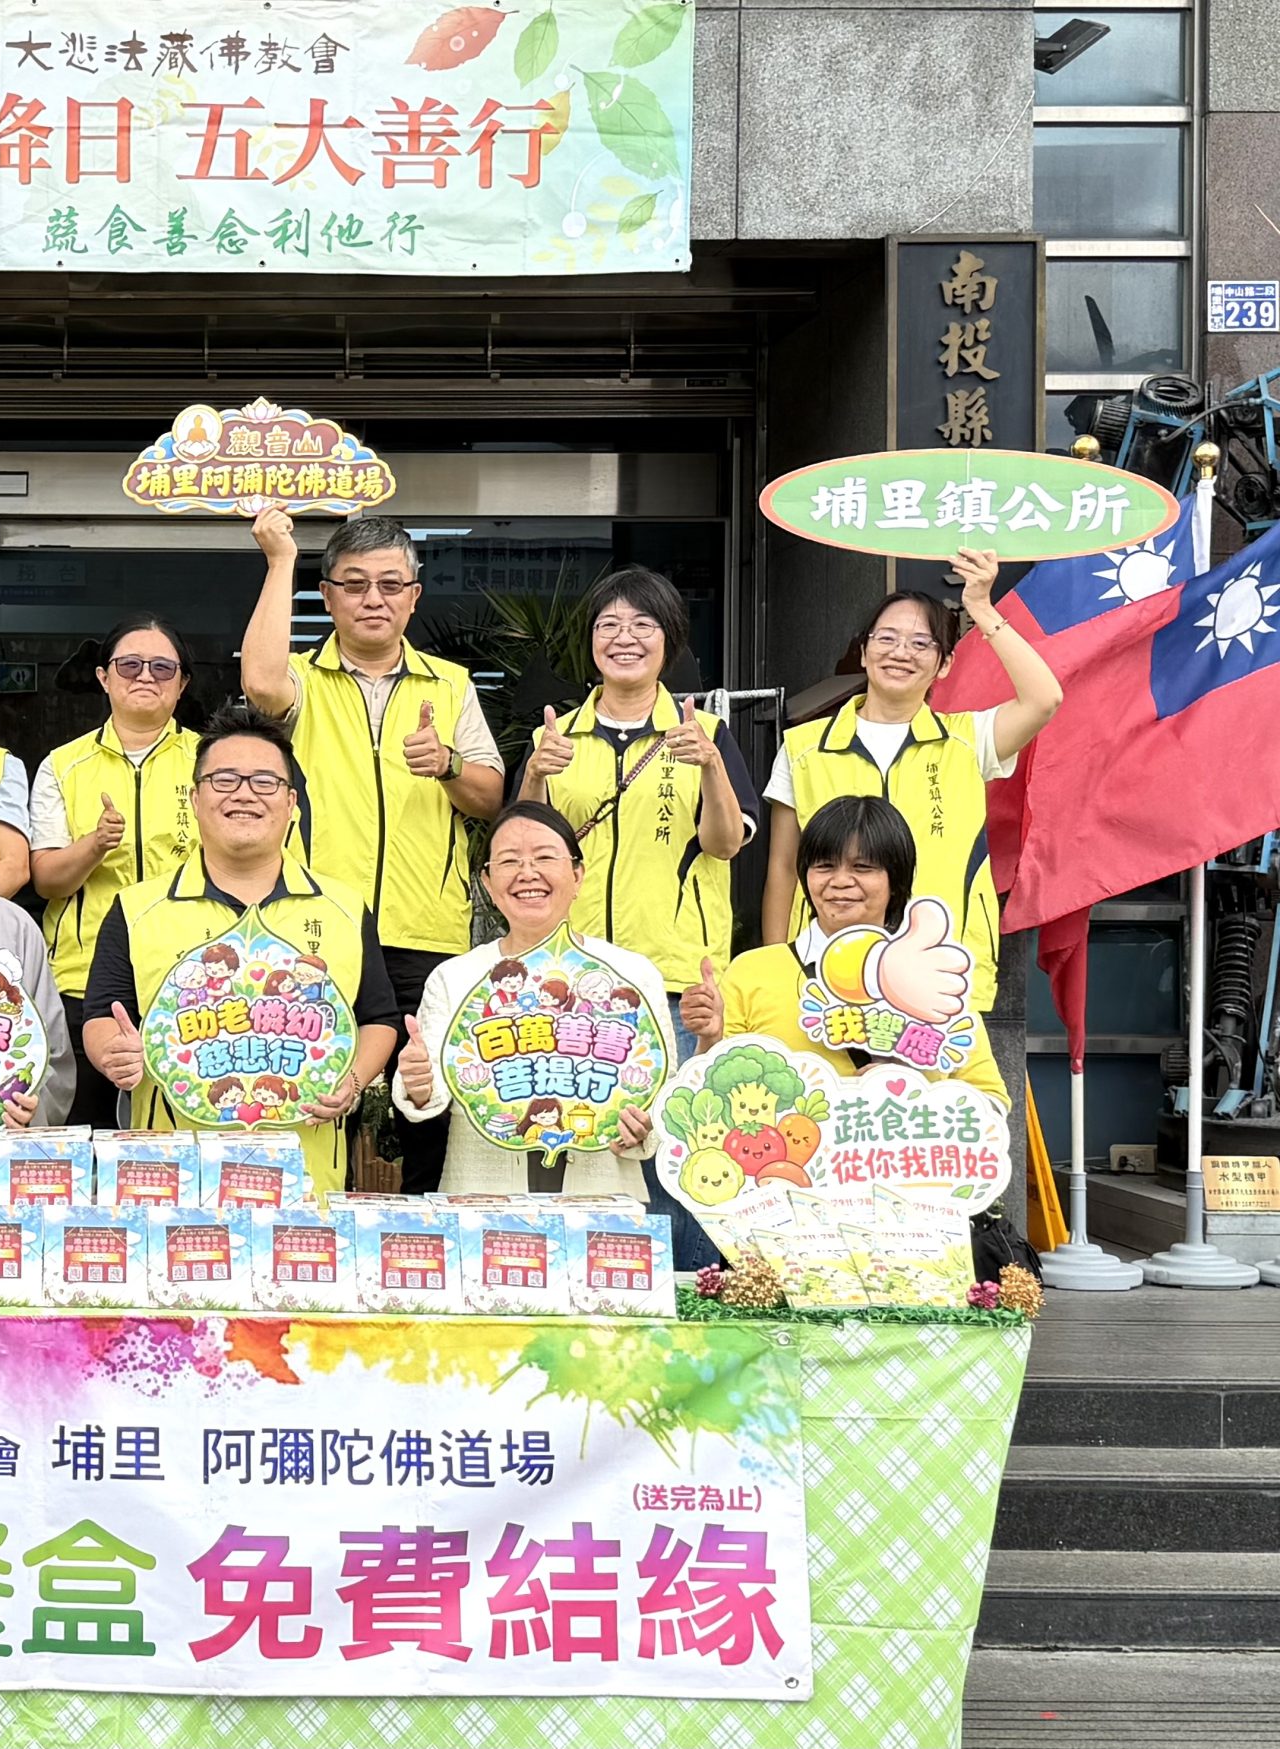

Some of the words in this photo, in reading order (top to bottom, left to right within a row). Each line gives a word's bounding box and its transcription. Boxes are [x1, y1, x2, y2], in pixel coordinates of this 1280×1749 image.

[175, 95, 560, 190] 五大善行
[40, 203, 426, 259] 蔬食善念利他行
[1226, 301, 1275, 327] 239
[938, 249, 1001, 447] 南投縣
[226, 425, 323, 457] 觀音山
[136, 462, 384, 499] 埔里阿彌陀佛道場
[810, 475, 1131, 537] 埔里鎮公所
[176, 997, 322, 1044] 助老憐幼
[472, 1013, 636, 1063] 百萬善書
[824, 1005, 946, 1066] 我響應
[196, 1036, 307, 1079] 慈悲行
[492, 1055, 619, 1103] 菩提行
[833, 1097, 981, 1145] 蔬食生活
[830, 1144, 999, 1185] 從你我開始
[51, 1424, 166, 1482] 埔里
[200, 1426, 557, 1487] 阿彌陀佛道場
[631, 1481, 763, 1513] (送完為止)
[186, 1521, 787, 1668] 免費結緣
